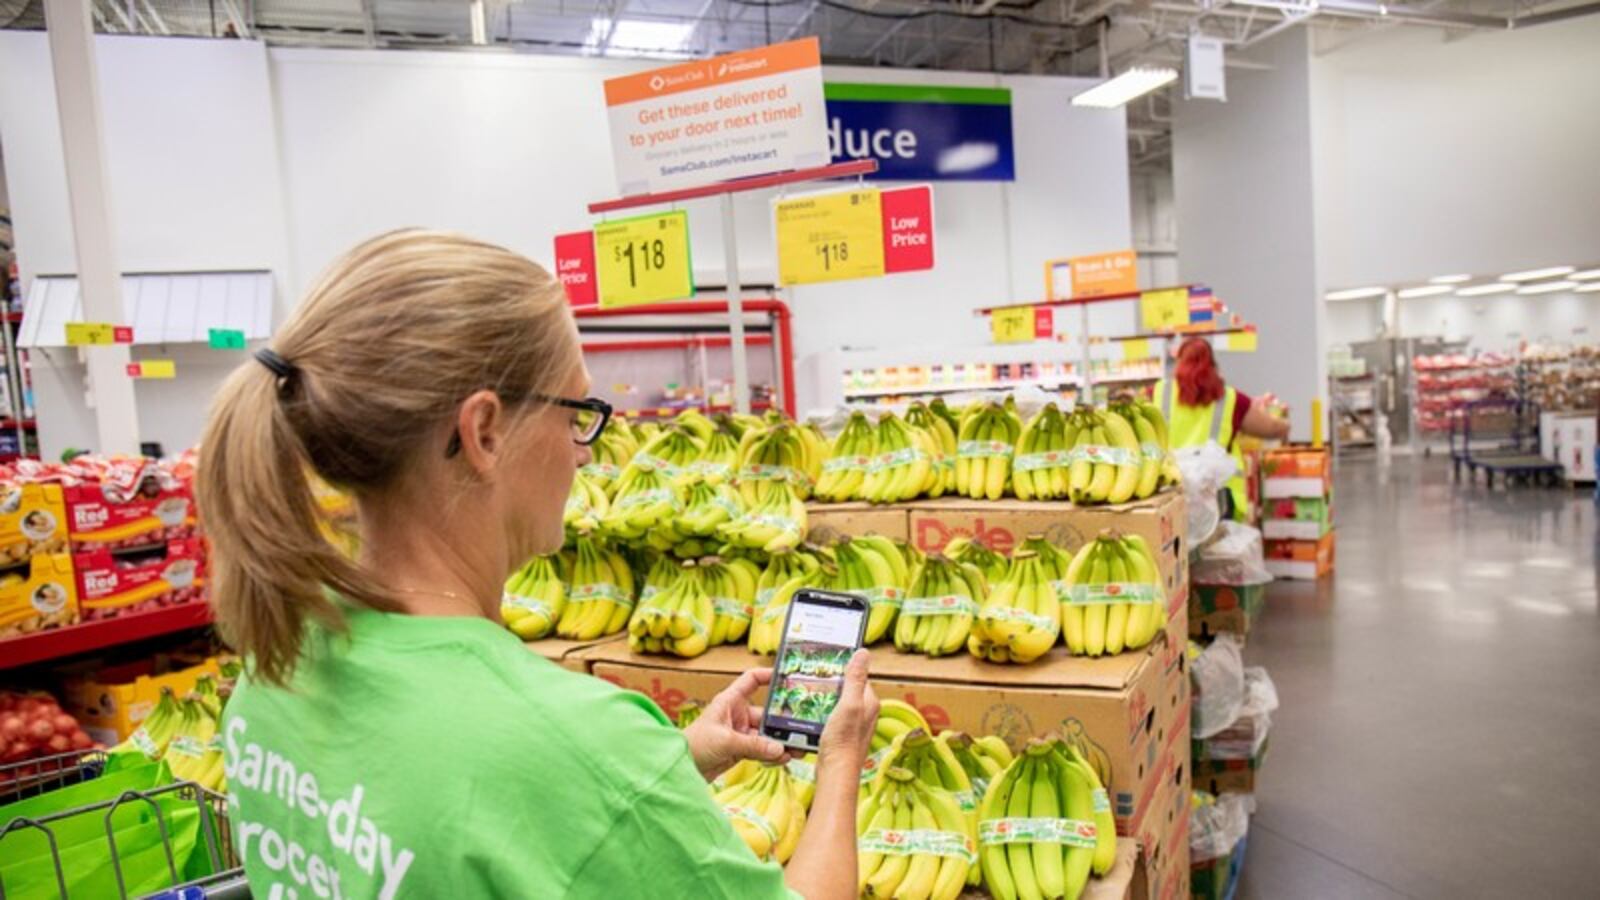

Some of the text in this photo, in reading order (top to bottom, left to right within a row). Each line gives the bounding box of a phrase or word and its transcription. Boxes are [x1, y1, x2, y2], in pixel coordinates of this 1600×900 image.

[638, 85, 788, 125] Get these delivered
[629, 103, 803, 151] to your door next time!
[891, 216, 919, 231] Low
[892, 232, 927, 248] Price
[558, 258, 582, 272] Low
[560, 271, 589, 286] Price
[75, 508, 109, 524] Red
[85, 574, 118, 589] Red
[225, 715, 415, 900] Same-day
